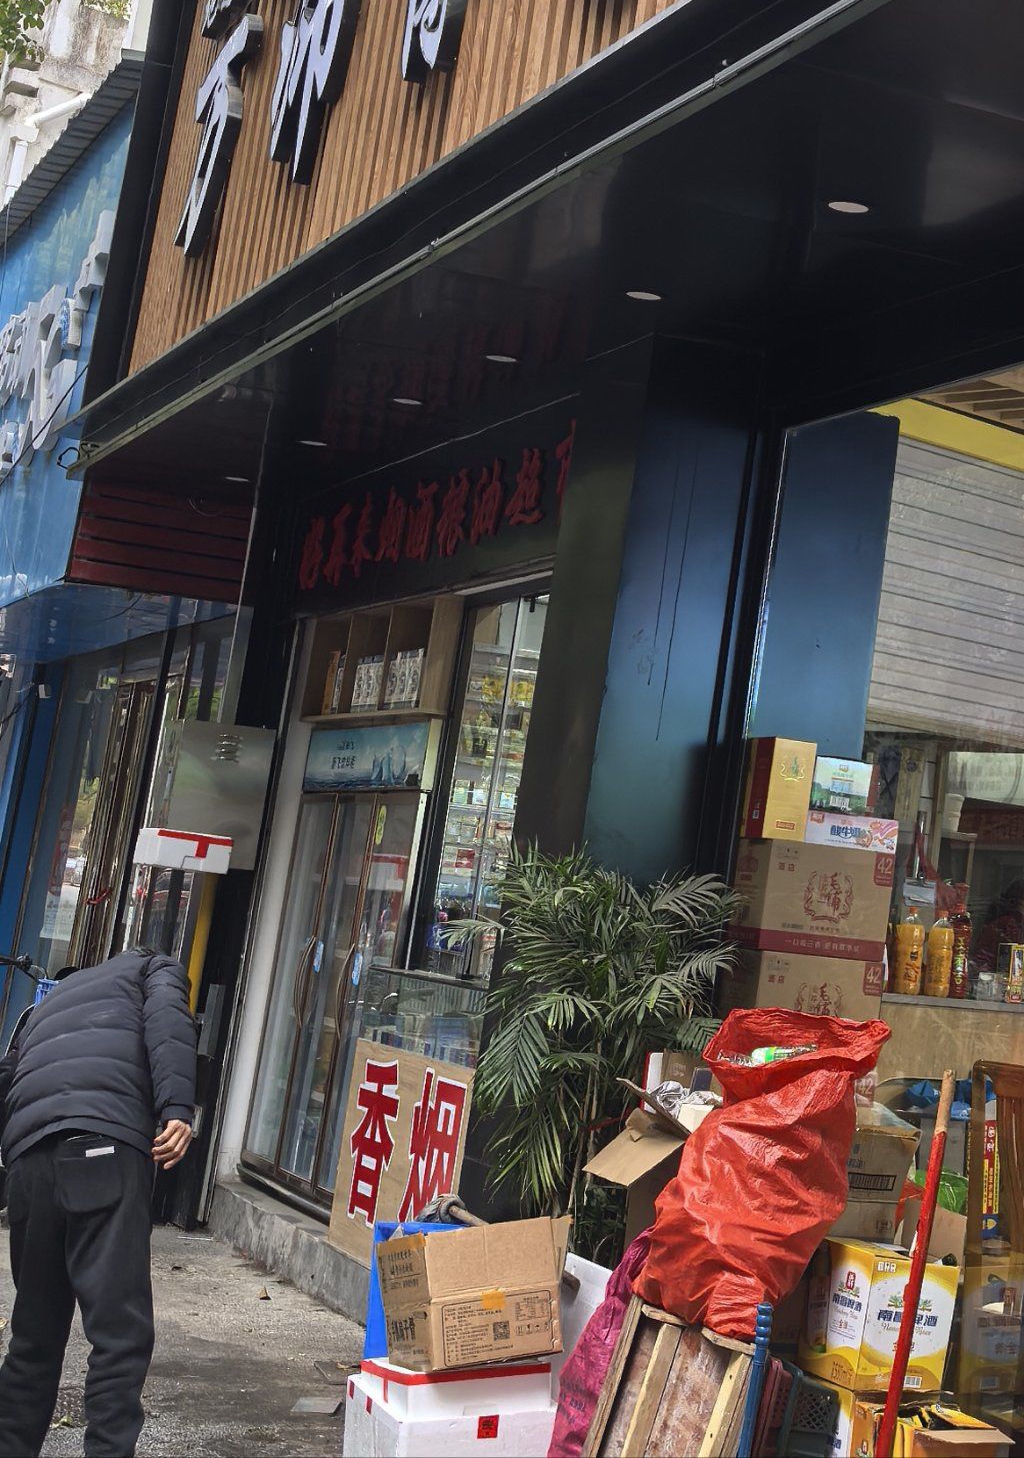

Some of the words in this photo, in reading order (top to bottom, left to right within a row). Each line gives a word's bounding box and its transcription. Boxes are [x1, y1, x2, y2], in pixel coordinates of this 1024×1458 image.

[877, 858, 893, 874] 42
[866, 967, 882, 984] 42
[855, 1078, 874, 1094] 42
[346, 1057, 469, 1229] 香烟
